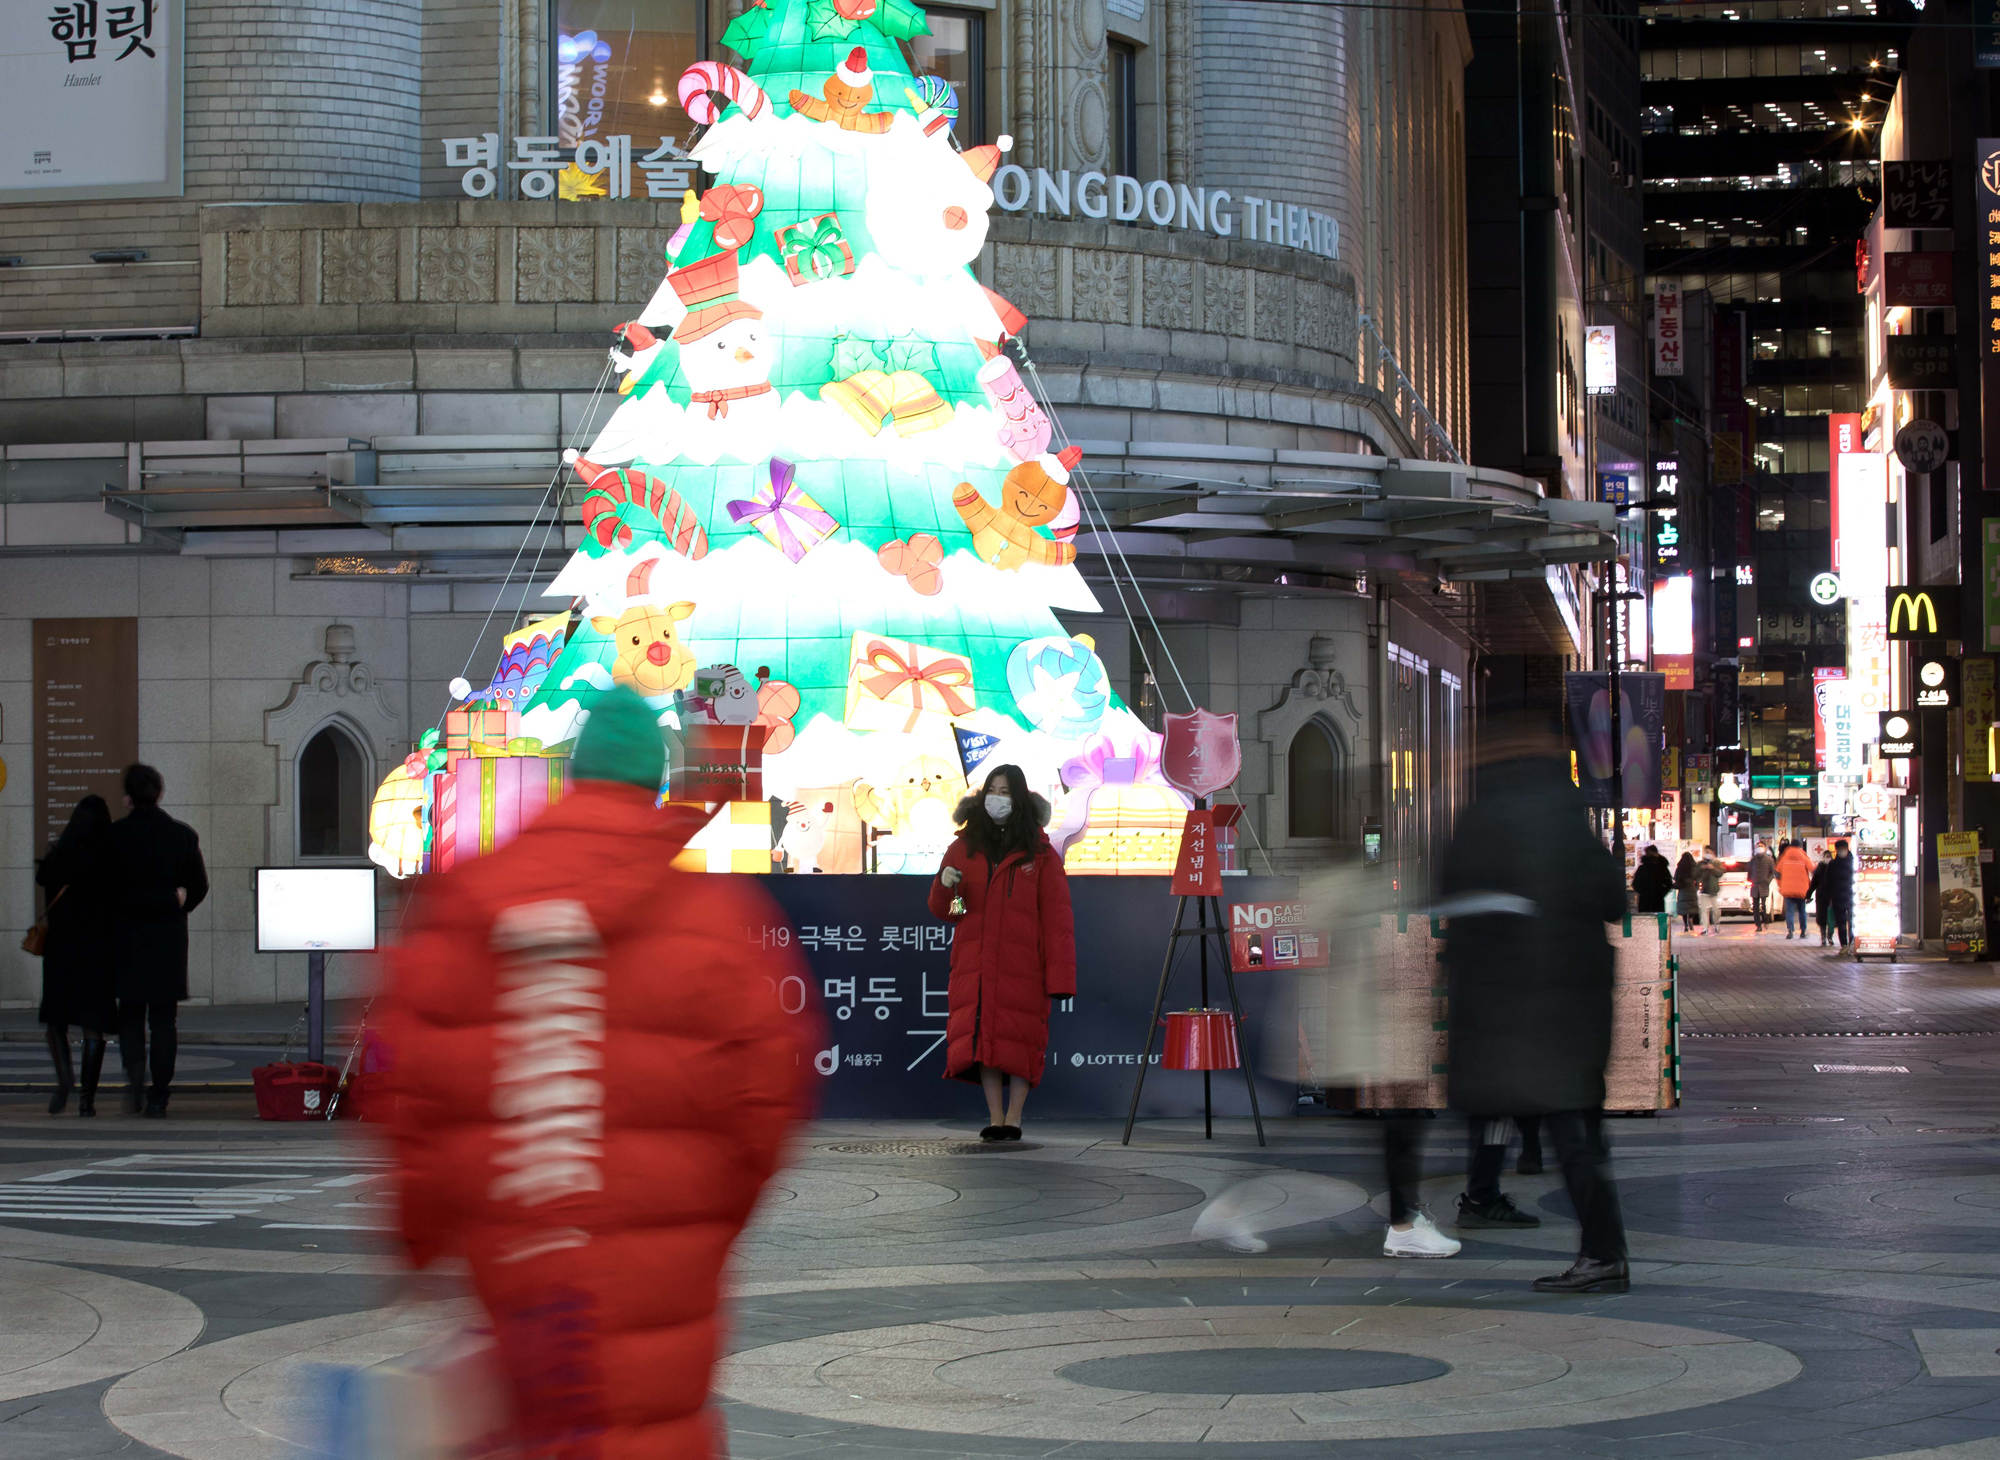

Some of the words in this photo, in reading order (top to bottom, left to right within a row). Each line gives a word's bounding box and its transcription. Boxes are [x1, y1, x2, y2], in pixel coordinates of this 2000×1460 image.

[48, 0, 155, 63] 햄릿
[63, 74, 102, 87] Hamlet
[441, 132, 699, 198] 명동예술
[1885, 163, 1949, 188] 강남
[1889, 188, 1950, 221] 면옥
[1241, 196, 1340, 261] THEATER
[1659, 294, 1680, 362] 부동산
[1894, 344, 1949, 358] Korea
[1838, 423, 1852, 453] RED
[1656, 461, 1678, 470] STAR
[1605, 481, 1625, 491] 번역
[1657, 547, 1678, 556] Cafe
[962, 734, 989, 748] VISIT
[1188, 720, 1213, 786] 구세군
[699, 763, 749, 774] MERRY
[1943, 832, 1971, 841] MONEY
[1189, 822, 1207, 886] 자선냄비
[1233, 904, 1274, 929] NO
[798, 925, 867, 951] 극복은
[1969, 939, 1985, 953] 5F
[824, 976, 903, 1020] 명동
[844, 1053, 883, 1066] 서울중구
[1087, 1055, 1135, 1064] LOTTE
